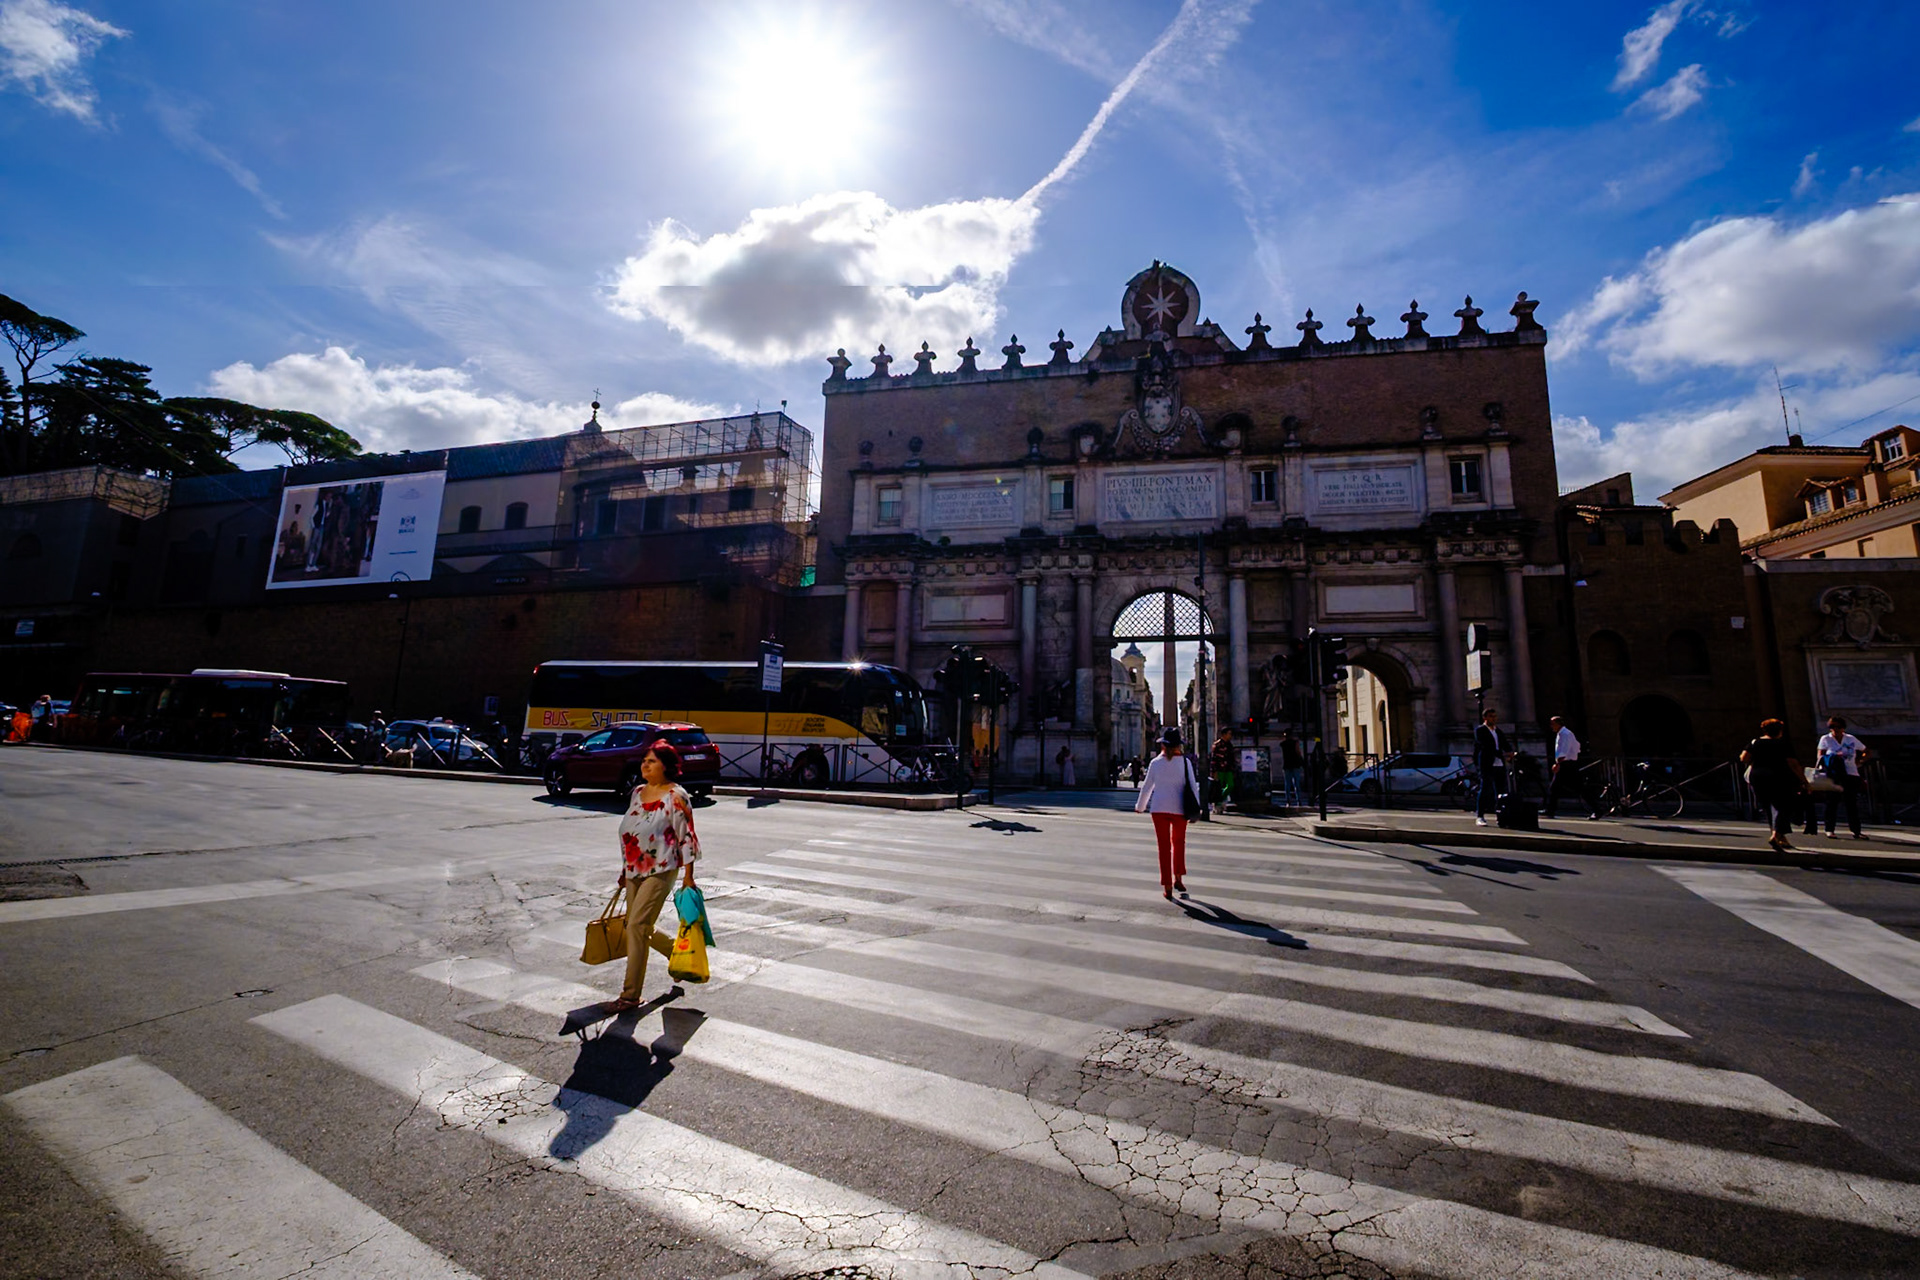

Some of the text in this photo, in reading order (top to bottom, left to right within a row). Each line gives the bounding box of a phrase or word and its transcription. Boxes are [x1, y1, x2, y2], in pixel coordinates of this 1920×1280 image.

[1106, 479, 1129, 489] PIVS
[1149, 476, 1181, 487] PONT
[1185, 475, 1212, 485] MAX
[543, 710, 653, 727] BUS SHUTTLE
